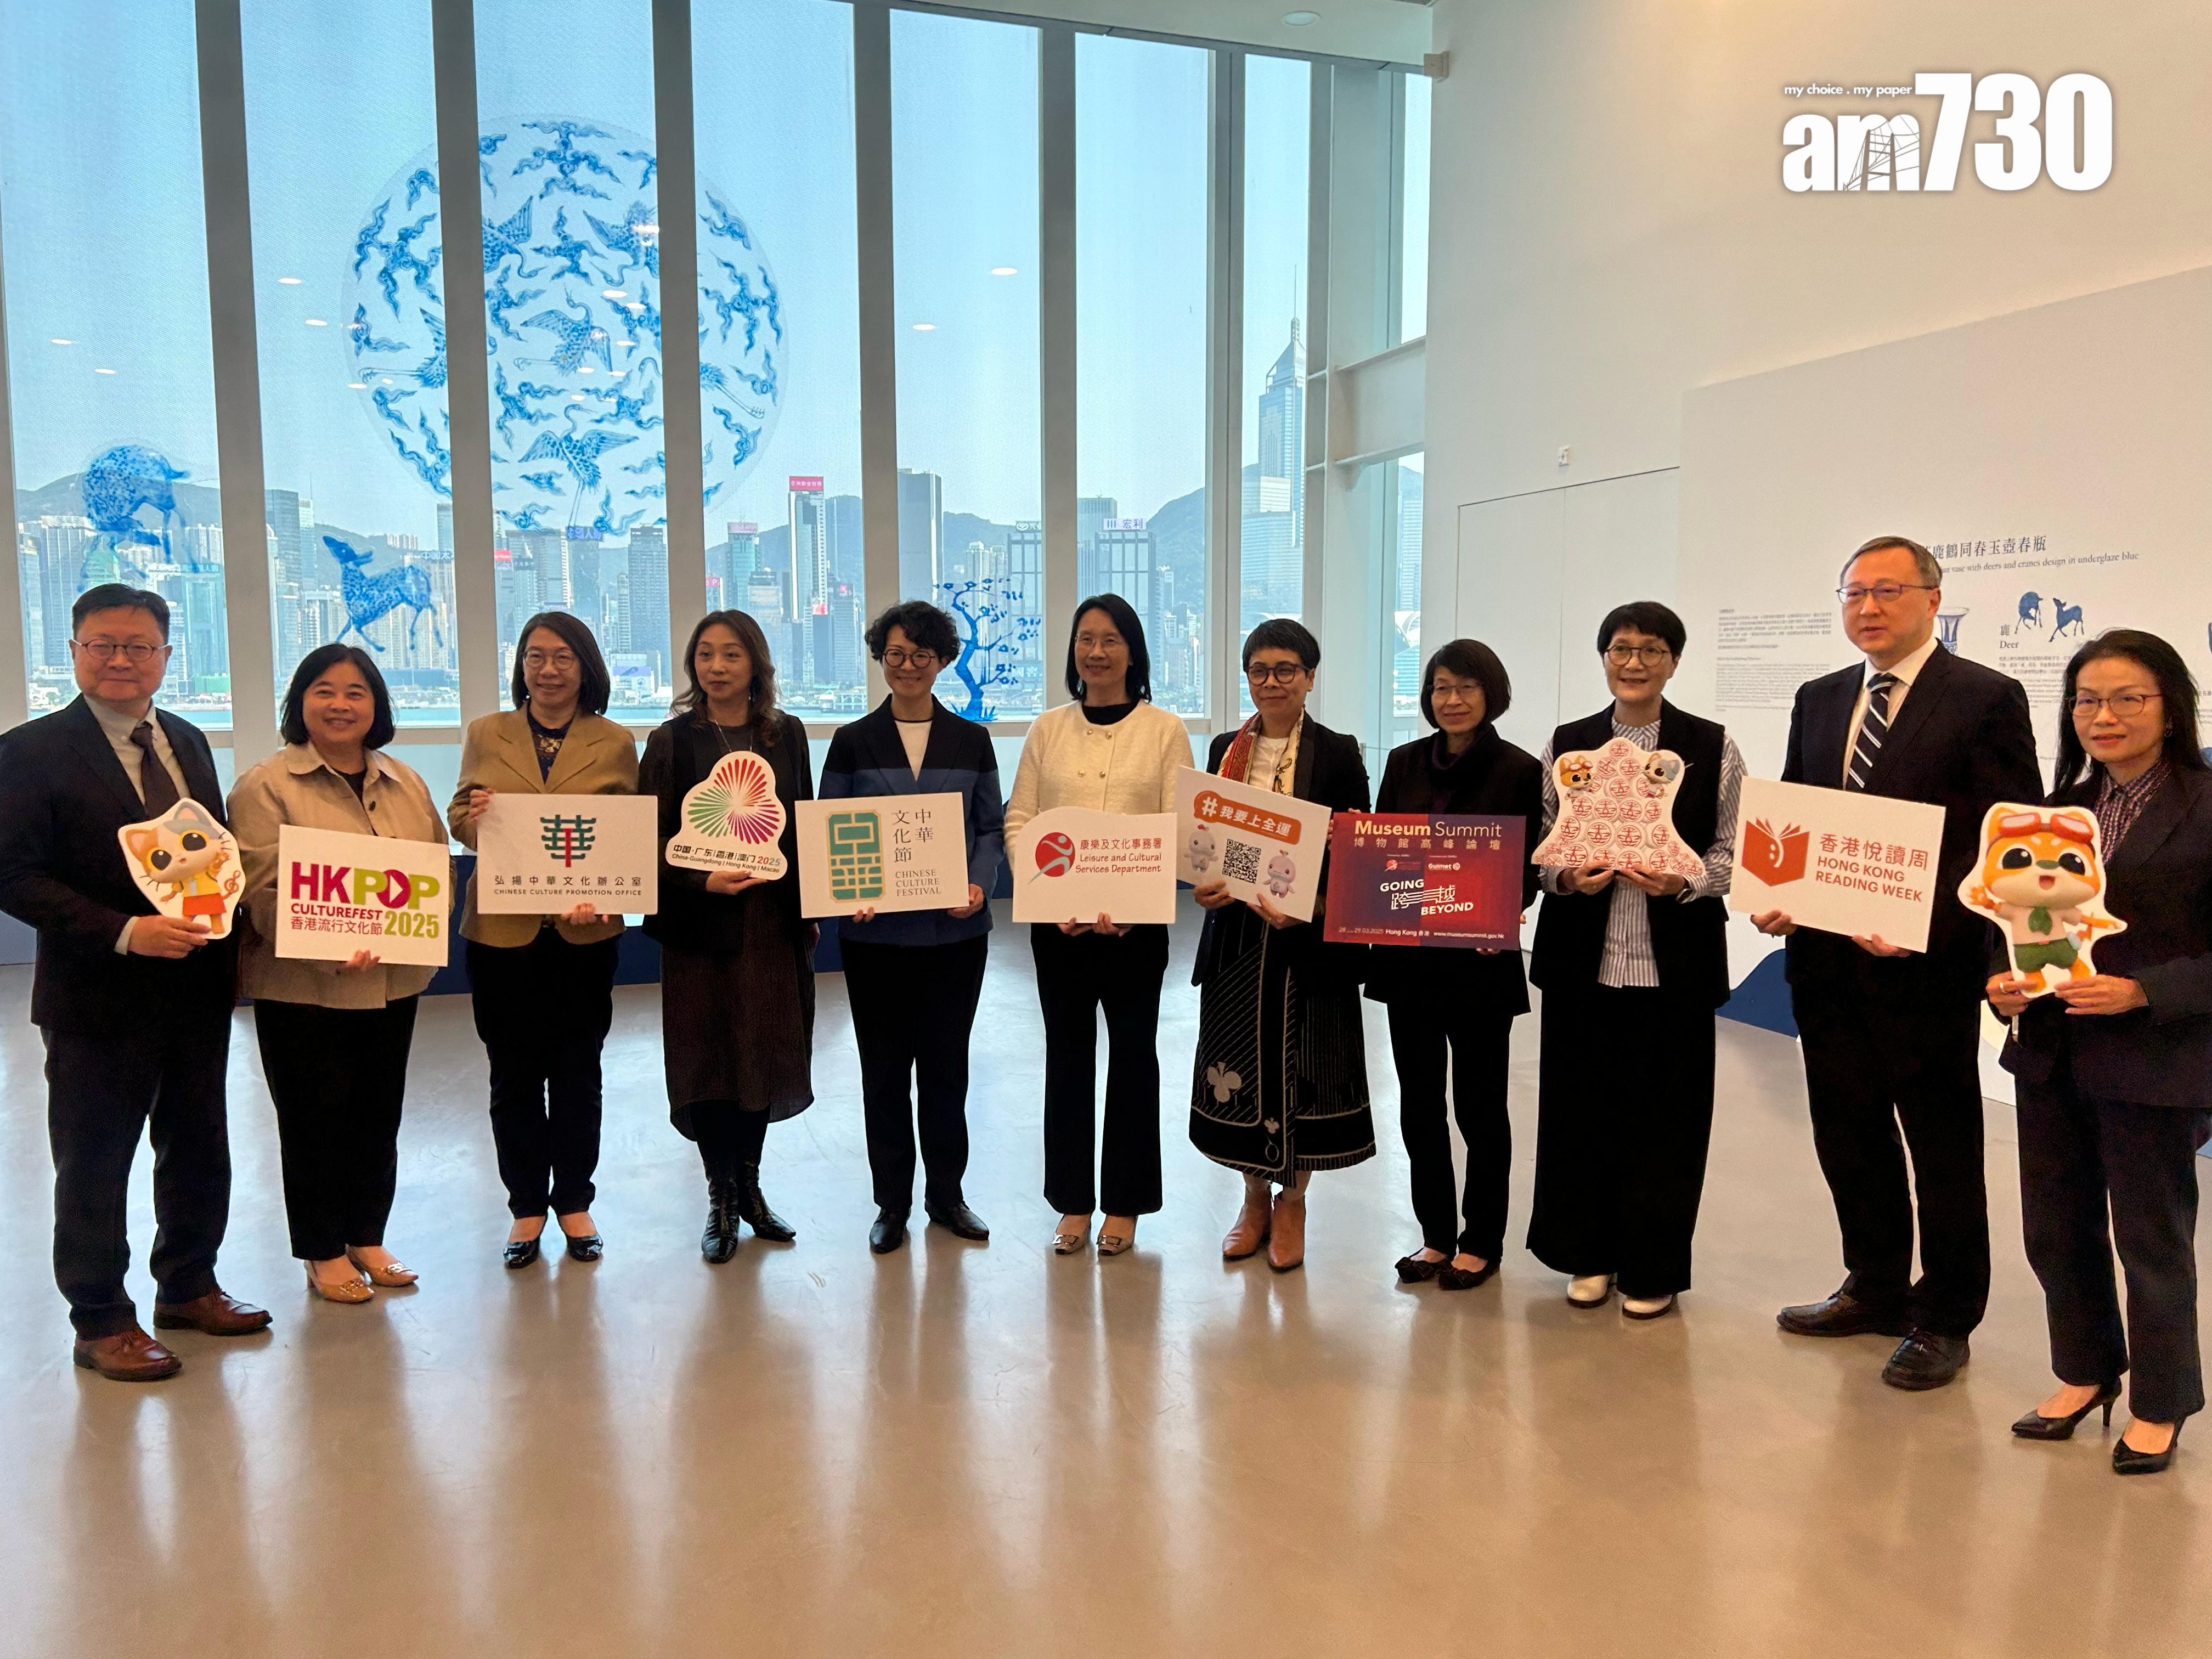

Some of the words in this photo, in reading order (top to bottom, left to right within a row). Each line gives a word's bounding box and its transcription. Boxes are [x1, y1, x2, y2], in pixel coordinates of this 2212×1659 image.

[1122, 518, 1143, 529] 宏利
[1925, 535, 2046, 560] 鹿鶴同春玉壺春瓶
[1967, 563, 1981, 571] with
[1984, 562, 2002, 570] deers
[2004, 560, 2016, 568] and
[2042, 558, 2066, 567] design
[2078, 554, 2120, 566] underglaze
[2122, 551, 2139, 561] blue
[2000, 640, 2019, 648] Deer
[915, 809, 934, 843] 中華
[1355, 820, 1431, 836] Museum
[1435, 821, 1502, 837] Summit
[891, 810, 911, 863] 文化節
[1080, 838, 1162, 850] 康樂及文化事務署
[1354, 837, 1500, 850] 博物館高峰論壇
[757, 856, 781, 867] 2025
[1080, 854, 1109, 862] Leisure
[1129, 853, 1161, 861] Cultural
[895, 869, 937, 878] CHINESE
[1075, 865, 1109, 873] Services
[1111, 864, 1161, 876] Department
[1818, 856, 1859, 873] HONG
[1863, 864, 1904, 882] KONG
[896, 878, 940, 888] CULTURE
[1380, 879, 1424, 892] GOING
[1816, 871, 1878, 893] READING
[1882, 883, 1922, 902] WEEK
[896, 887, 941, 896] FESTIVAL
[291, 903, 383, 921] CULTUREFEST
[1421, 902, 1474, 916] BEYOND
[291, 916, 382, 935] 香港流行文化節
[385, 910, 439, 939] 2025
